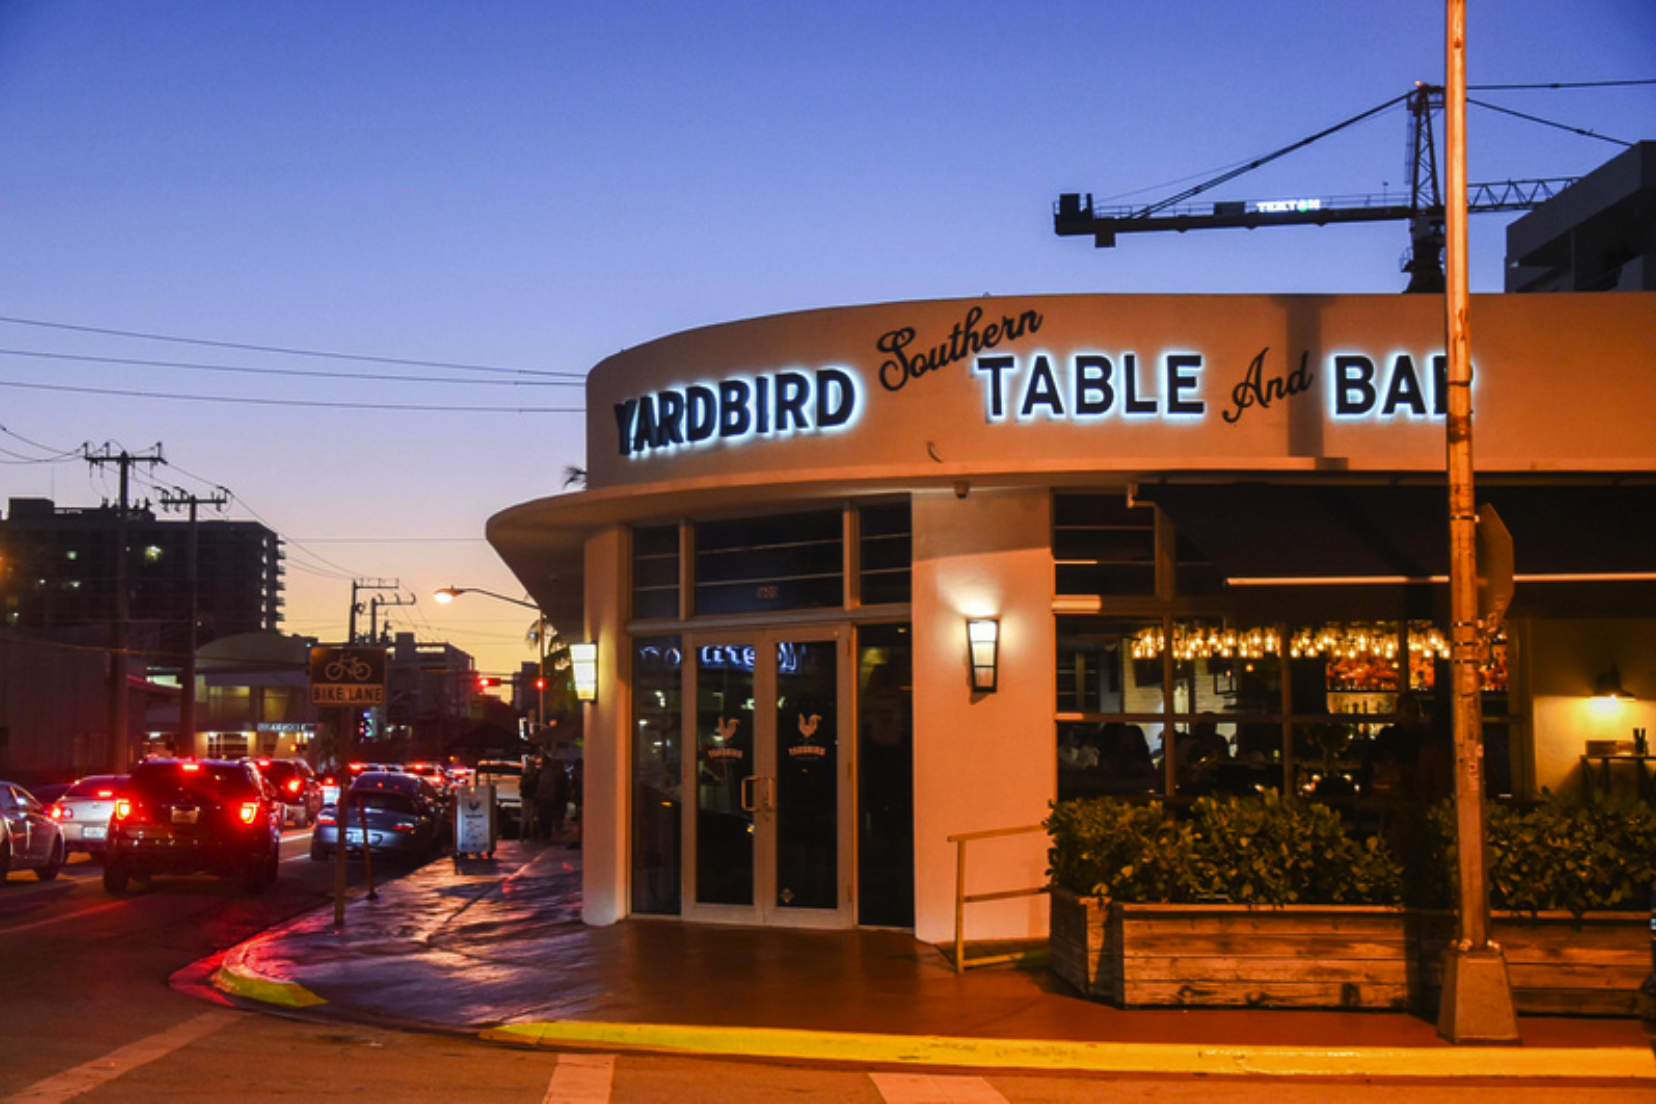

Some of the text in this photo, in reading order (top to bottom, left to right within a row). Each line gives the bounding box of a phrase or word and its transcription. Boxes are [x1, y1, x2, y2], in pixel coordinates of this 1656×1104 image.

[613, 368, 856, 456] YARDBIRD
[876, 306, 1043, 392] Southern
[977, 354, 1205, 417] TABLE
[1222, 347, 1314, 423] And
[313, 686, 381, 701] BIKE LANE
